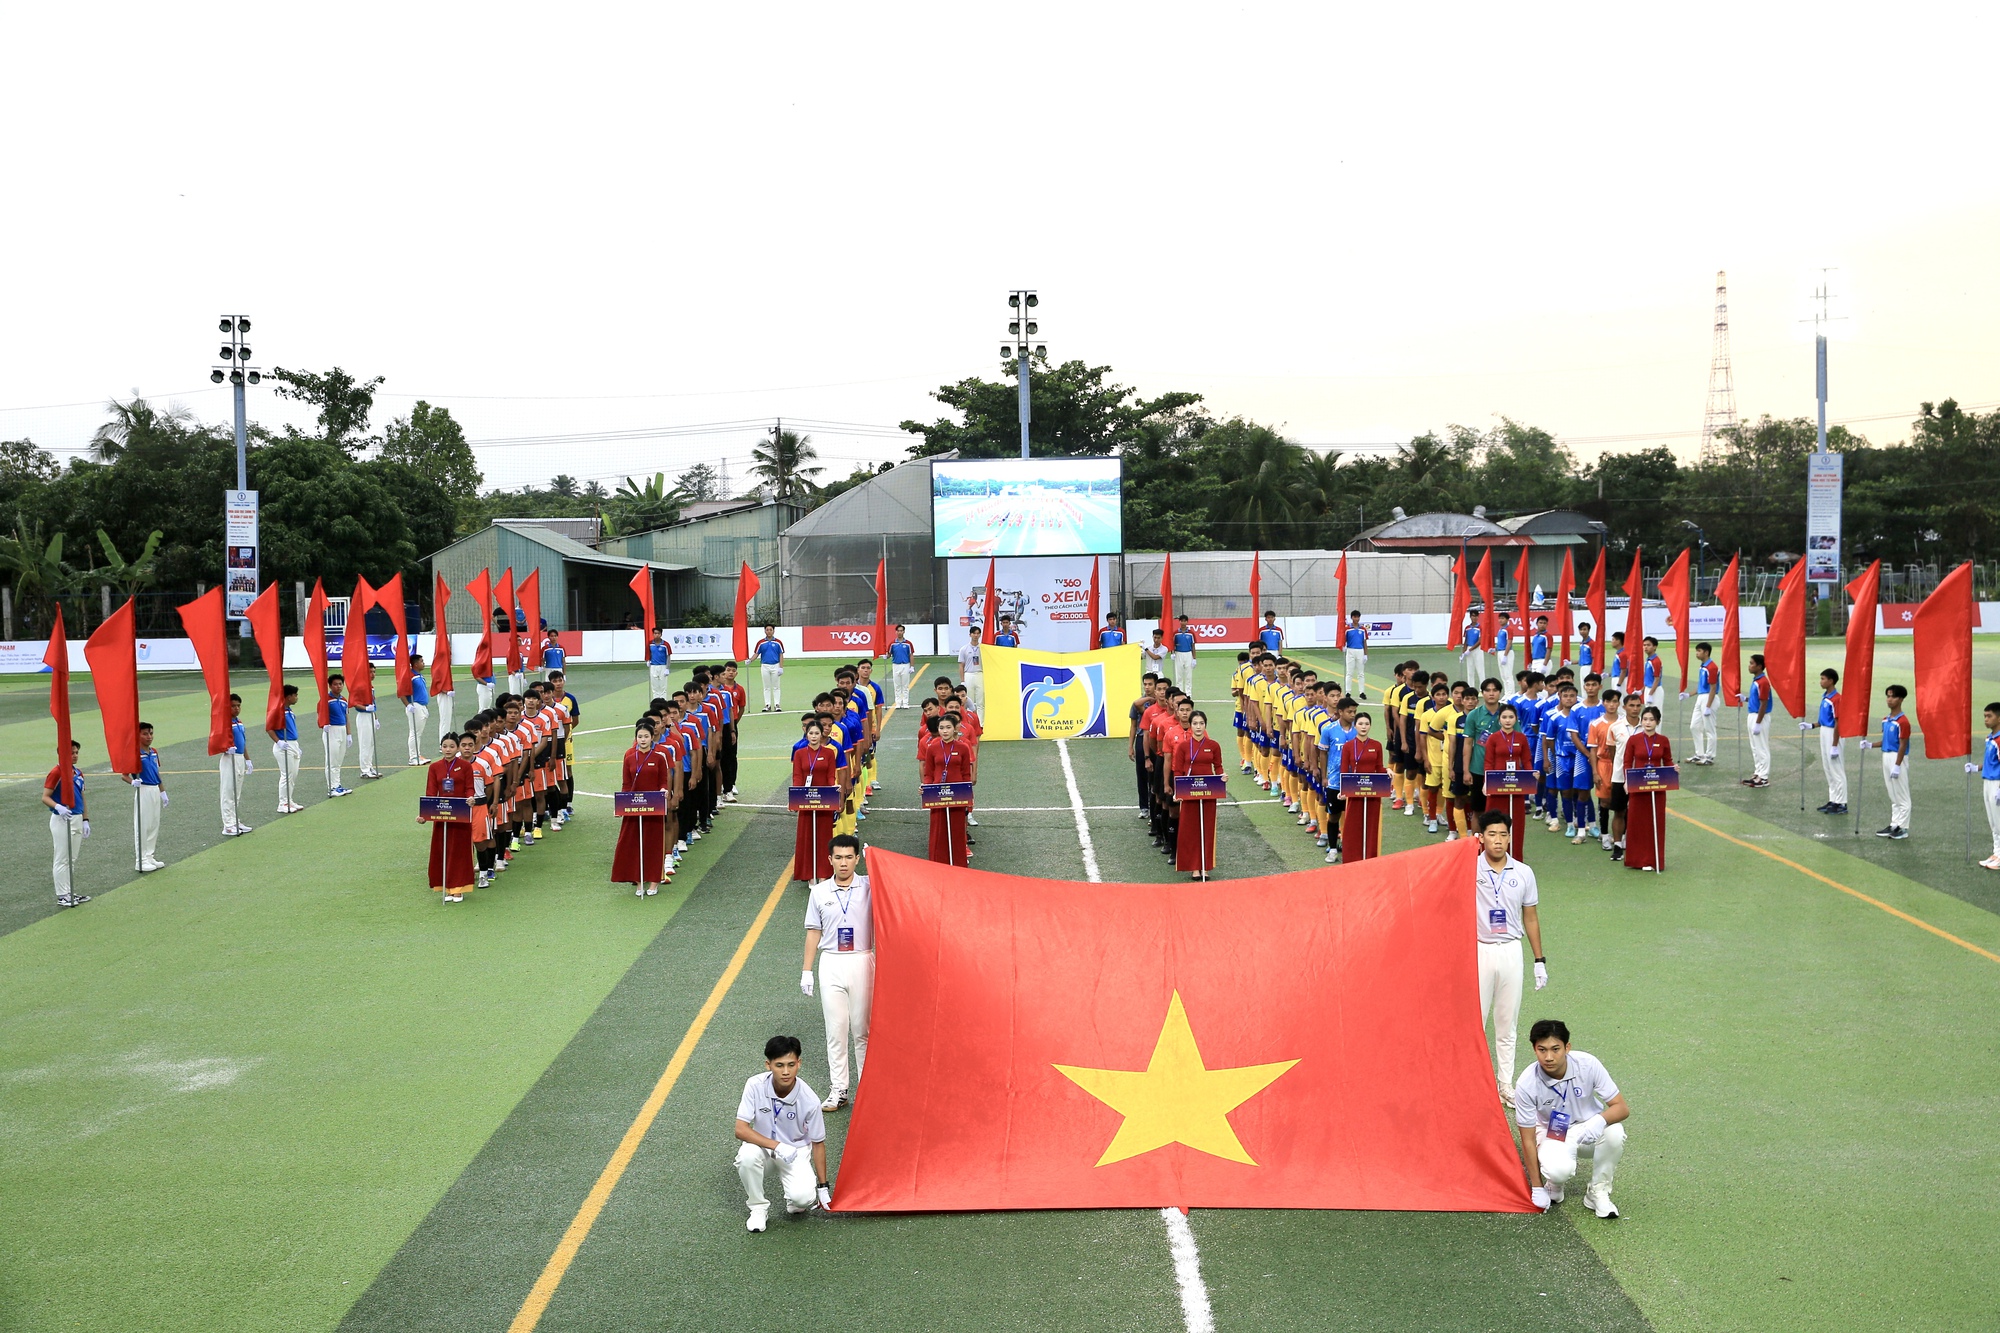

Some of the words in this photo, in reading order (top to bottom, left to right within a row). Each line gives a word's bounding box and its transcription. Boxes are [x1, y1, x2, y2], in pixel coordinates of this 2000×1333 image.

[1055, 578, 1082, 587] TV360
[1053, 590, 1089, 603] XEM
[1186, 624, 1227, 638] TV360
[830, 631, 871, 645] TV360
